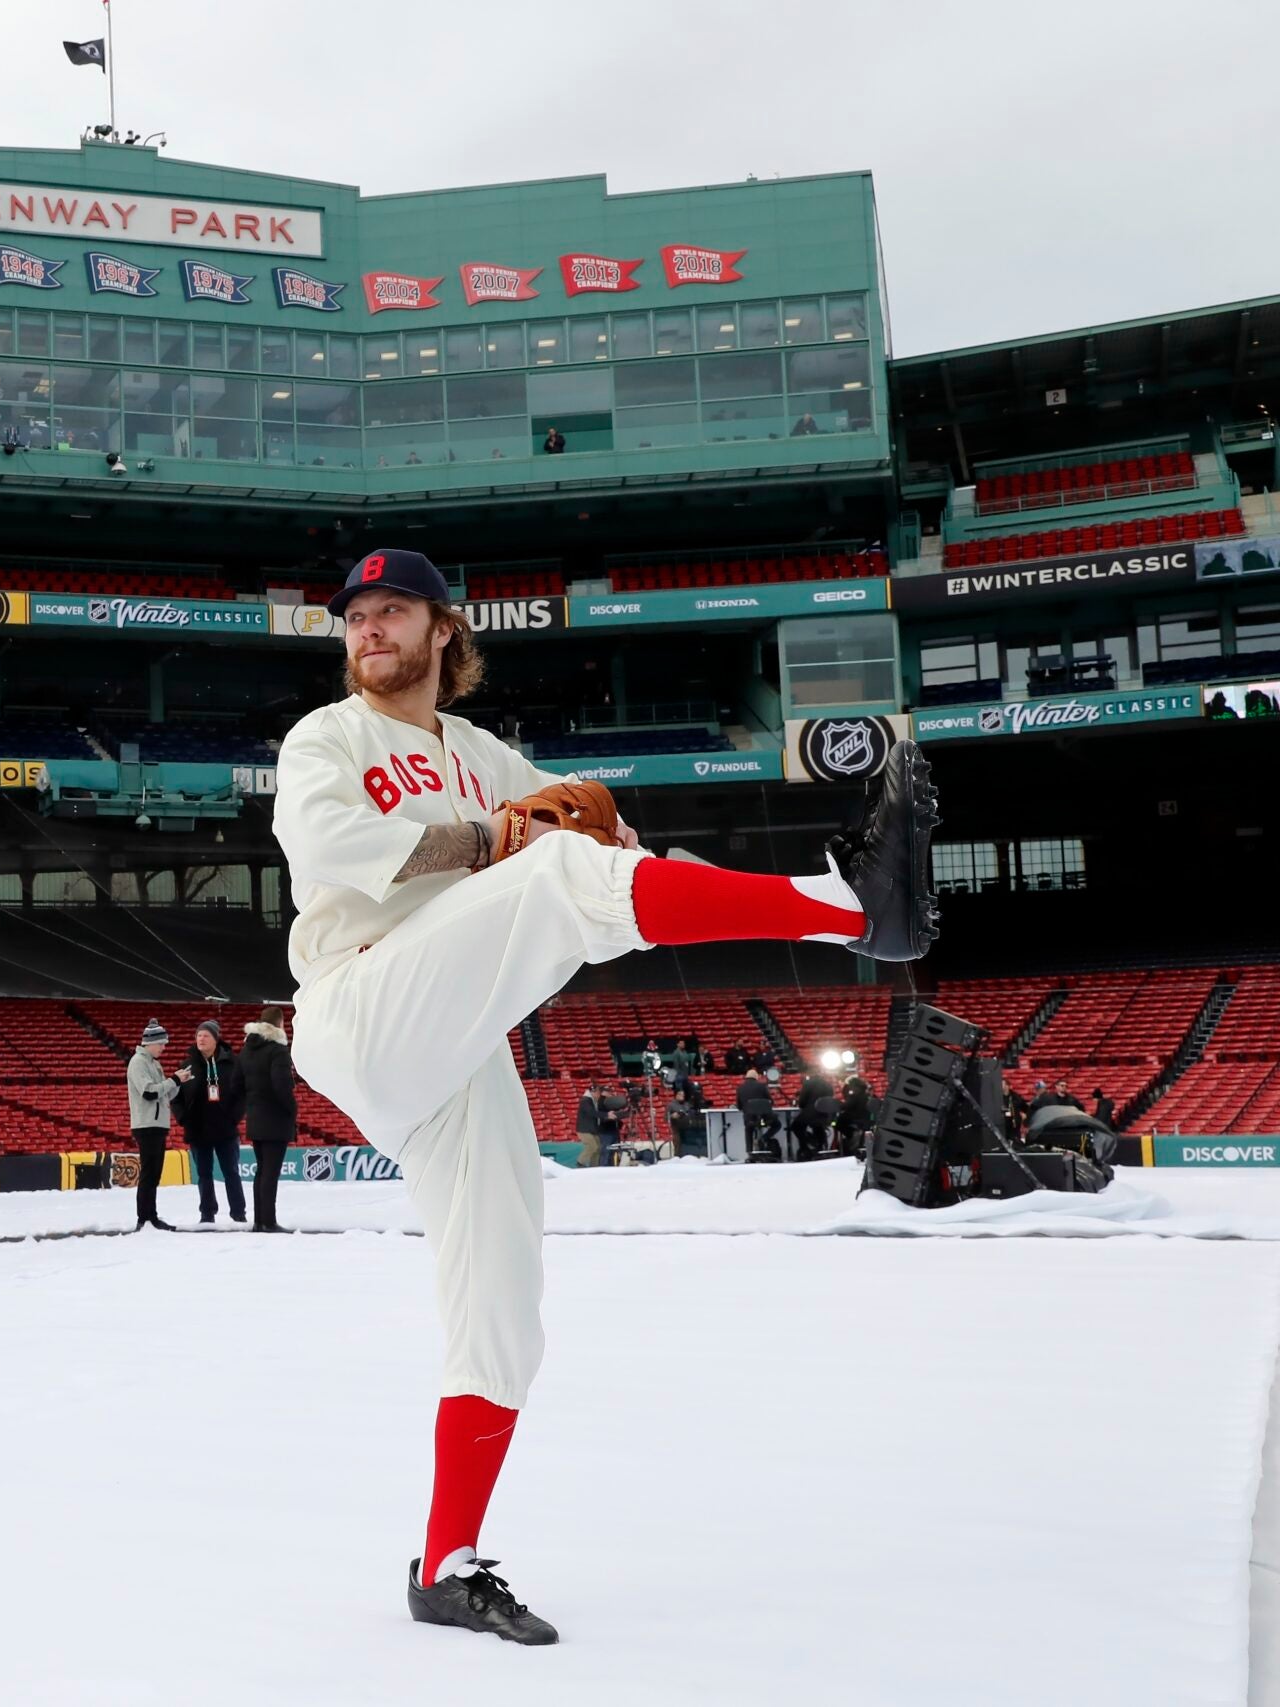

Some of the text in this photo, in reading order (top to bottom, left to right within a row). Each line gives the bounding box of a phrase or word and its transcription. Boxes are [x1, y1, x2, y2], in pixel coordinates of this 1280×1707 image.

[170, 207, 295, 244] PARK
[1, 254, 44, 280] 1946
[572, 263, 620, 283] 2013
[673, 255, 721, 274] 2018
[4, 271, 42, 285] CHAMPIONS
[97, 263, 140, 288] 1967
[192, 270, 234, 295] 1975
[471, 274, 520, 292] 2007
[577, 280, 617, 289] CHAMPIONS
[678, 272, 720, 280] CHAMPIONS
[101, 279, 138, 293] CHAMPIONS
[196, 286, 232, 300] CHAMPIONS
[285, 278, 326, 302] 1986
[374, 282, 420, 300] 2004
[476, 289, 517, 297] CHAMPIONS
[288, 294, 323, 308] CHAMPIONS
[380, 297, 417, 305] CHAMPIONS
[362, 556, 386, 583] B
[947, 553, 1188, 595] #WINTERCLASSIC
[708, 598, 759, 609] HONDA
[813, 589, 866, 603] GEICO
[36, 604, 85, 616] DISCOVER
[110, 599, 190, 628] Winter
[194, 611, 262, 624] CLASSIC
[451, 599, 552, 633] UINS
[589, 604, 641, 616] DISCOVER
[301, 610, 325, 632] P
[919, 717, 974, 731] DISCOVER
[1004, 700, 1100, 734] Winter
[1105, 697, 1193, 715] CLASSIC
[834, 735, 863, 763] NHL
[577, 766, 629, 780] verizon
[711, 761, 762, 773] FANDUEL
[1182, 1146, 1275, 1162] DISCOVER
[310, 1158, 329, 1179] NHL
